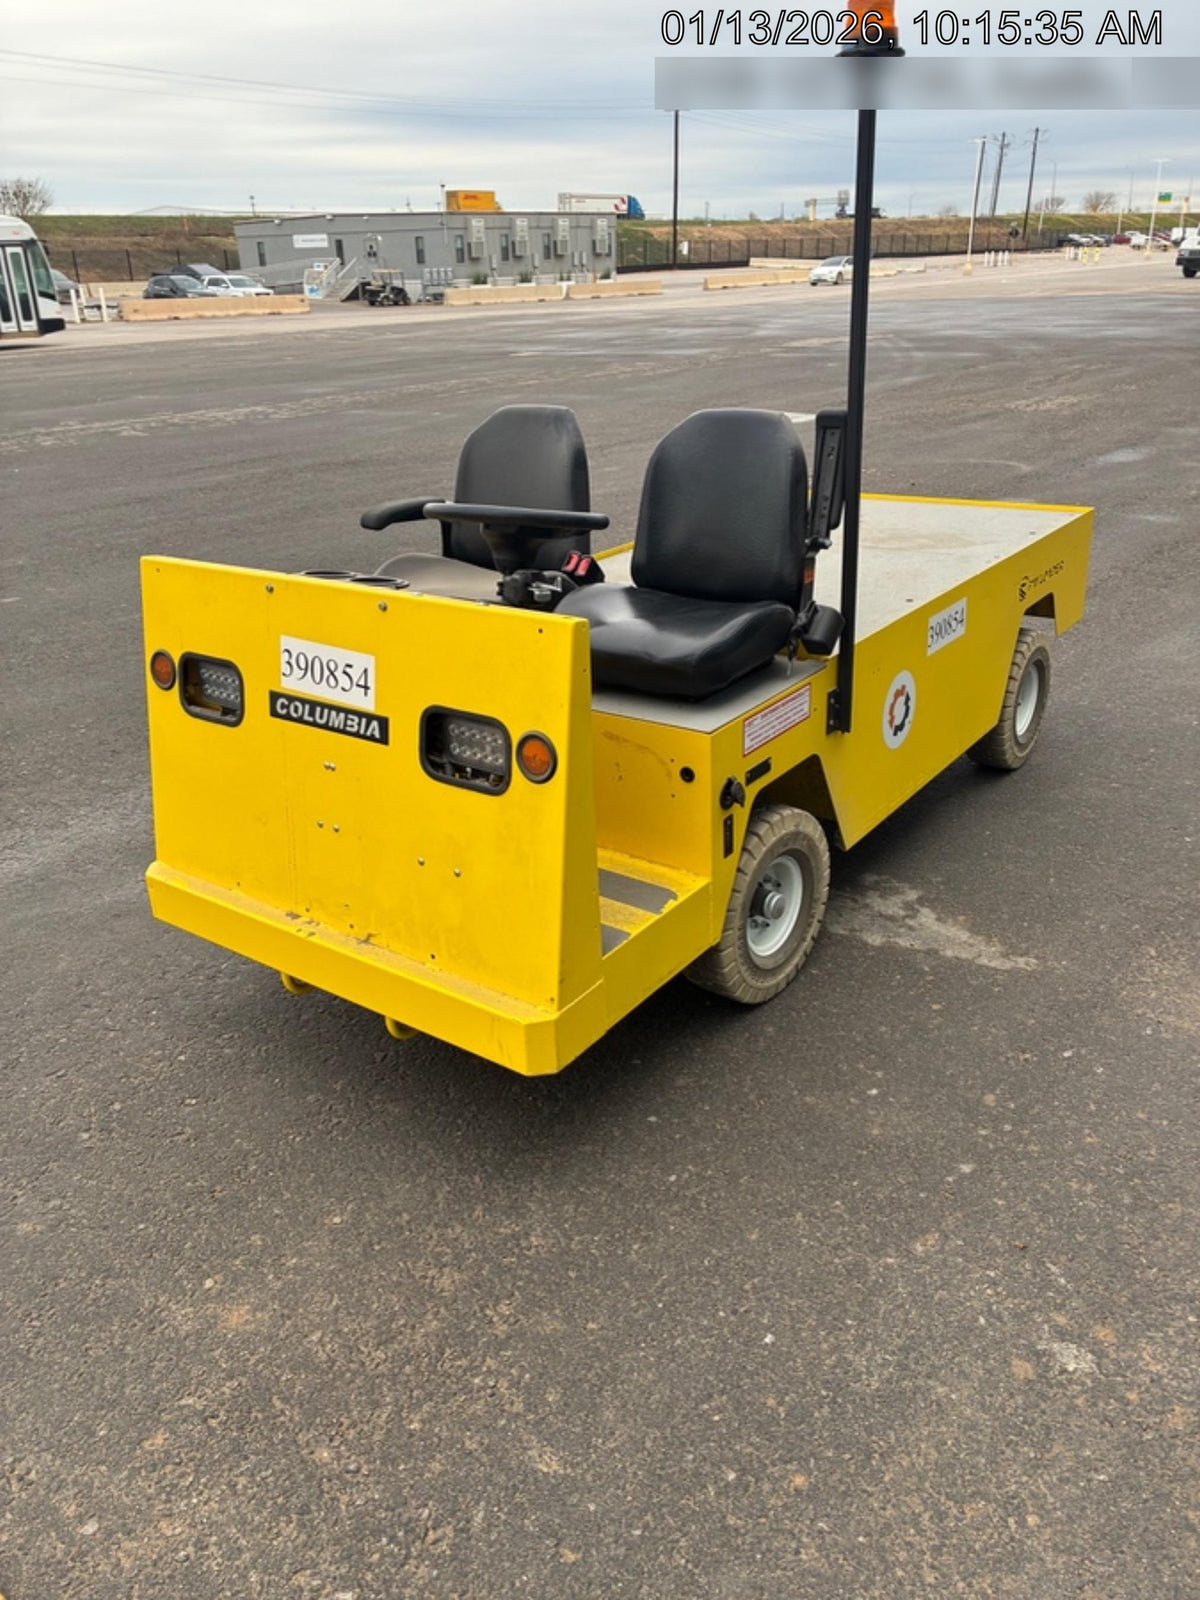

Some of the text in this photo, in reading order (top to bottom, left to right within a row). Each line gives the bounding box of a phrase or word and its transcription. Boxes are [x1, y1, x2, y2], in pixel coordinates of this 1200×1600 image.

[928, 607, 965, 648] 390854
[281, 648, 372, 697] 390854
[275, 697, 382, 740] COLUMBIA
